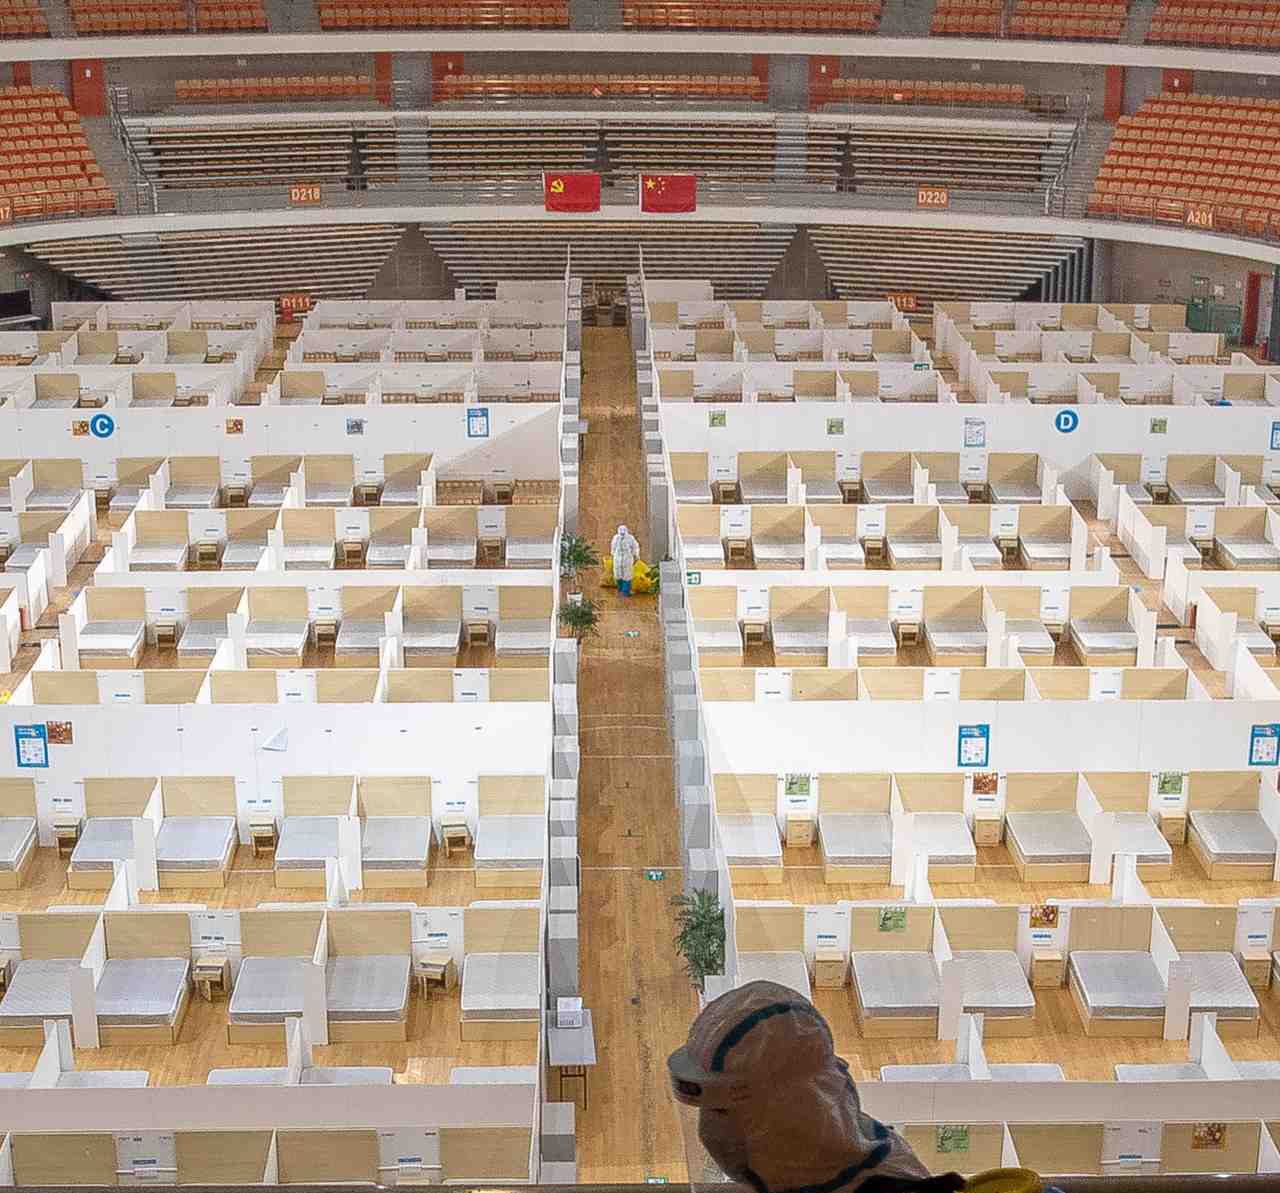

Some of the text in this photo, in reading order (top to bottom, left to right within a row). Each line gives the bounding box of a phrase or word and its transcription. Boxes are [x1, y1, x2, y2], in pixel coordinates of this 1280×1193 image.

[918, 191, 946, 204] D220
[1186, 211, 1213, 228] A201
[97, 418, 110, 434] C
[1060, 414, 1072, 430] D
